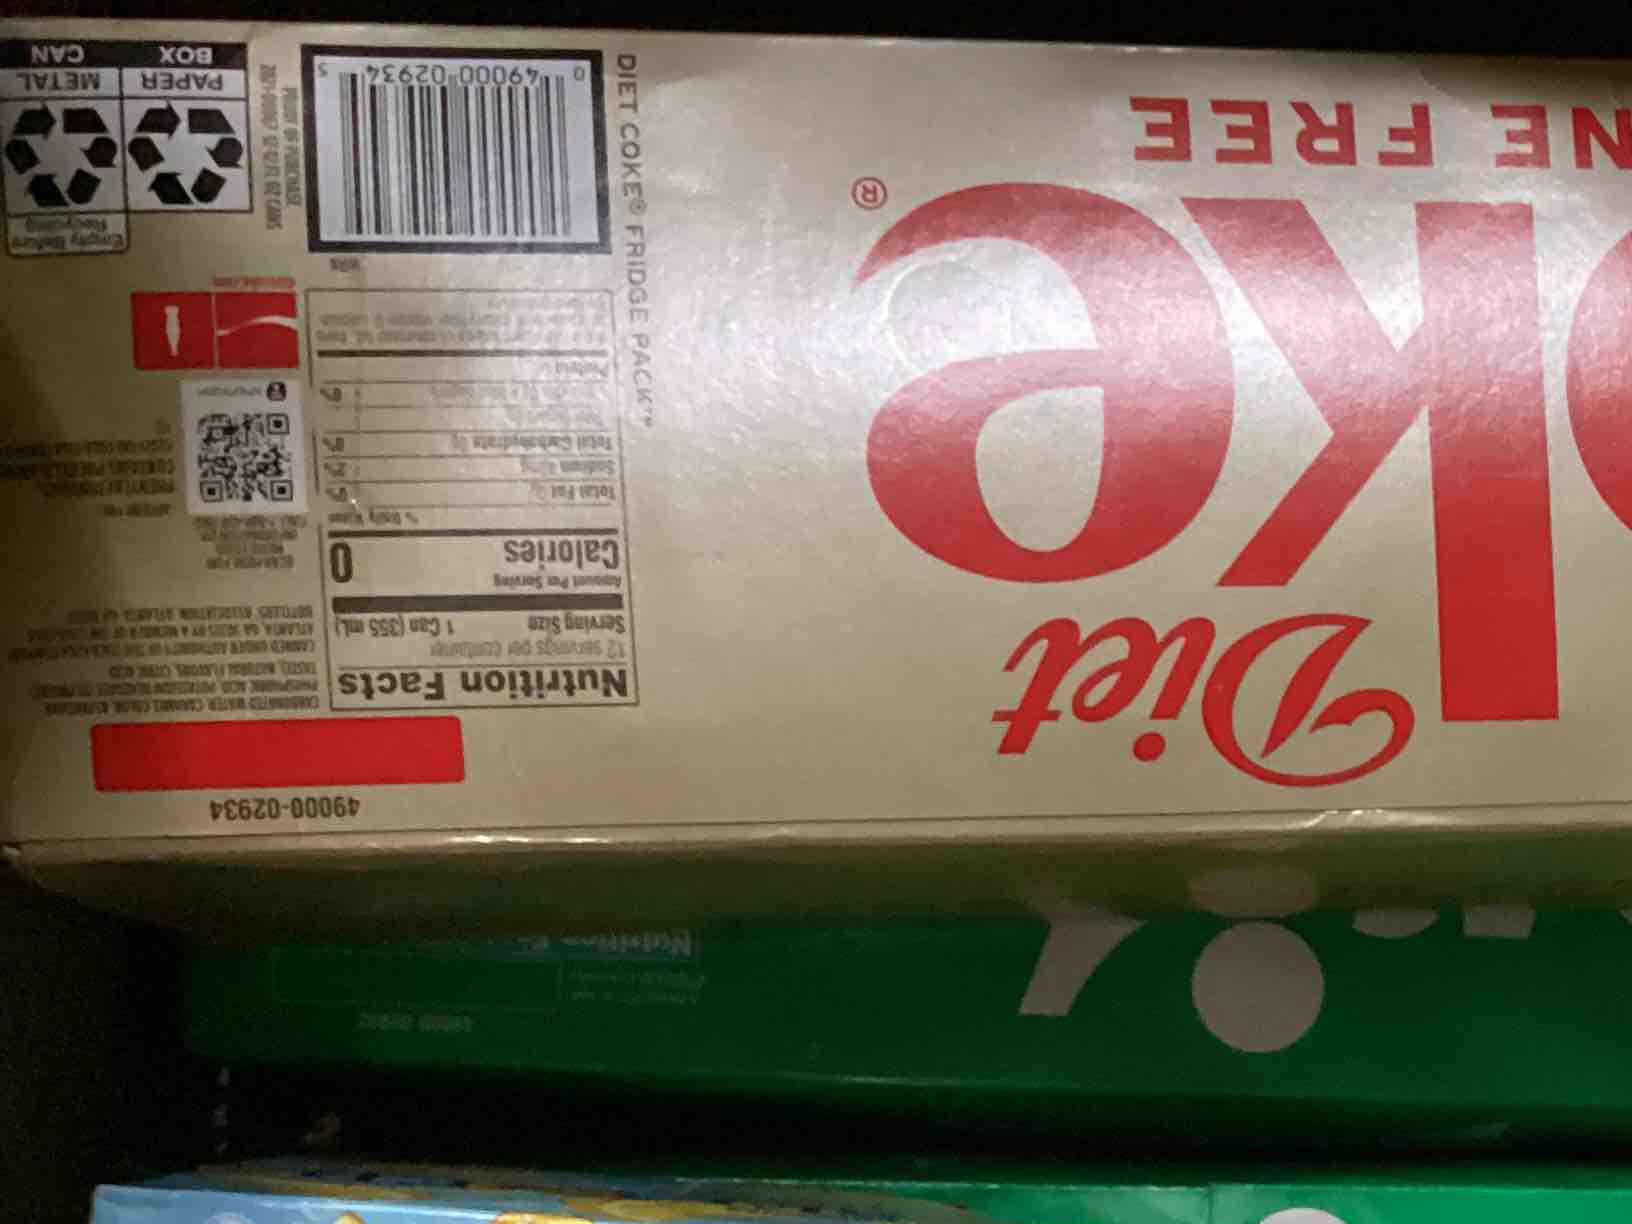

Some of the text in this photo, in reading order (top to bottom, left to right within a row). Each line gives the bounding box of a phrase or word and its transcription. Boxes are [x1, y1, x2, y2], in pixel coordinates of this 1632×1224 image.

[31, 46, 84, 63] CAN
[160, 46, 213, 64] BOX
[16, 73, 100, 91] METAL
[142, 72, 222, 91] PAPER
[318, 62, 585, 85] 0 49000 02934 5
[616, 54, 636, 113] DIET
[1129, 96, 1429, 169] FREE
[625, 224, 646, 322] FRIDGE
[330, 542, 353, 583] 0
[503, 539, 619, 569] Calories
[493, 574, 621, 589] Amount Per Serving
[334, 618, 365, 637] mL)
[369, 615, 404, 637] (355
[409, 618, 440, 635] Can
[528, 612, 625, 635] Serving Size
[428, 638, 625, 660] 12 servings per container
[338, 669, 628, 700] Nutrition Facts
[993, 614, 1415, 788] Diet
[209, 796, 360, 821] 49000-02934
